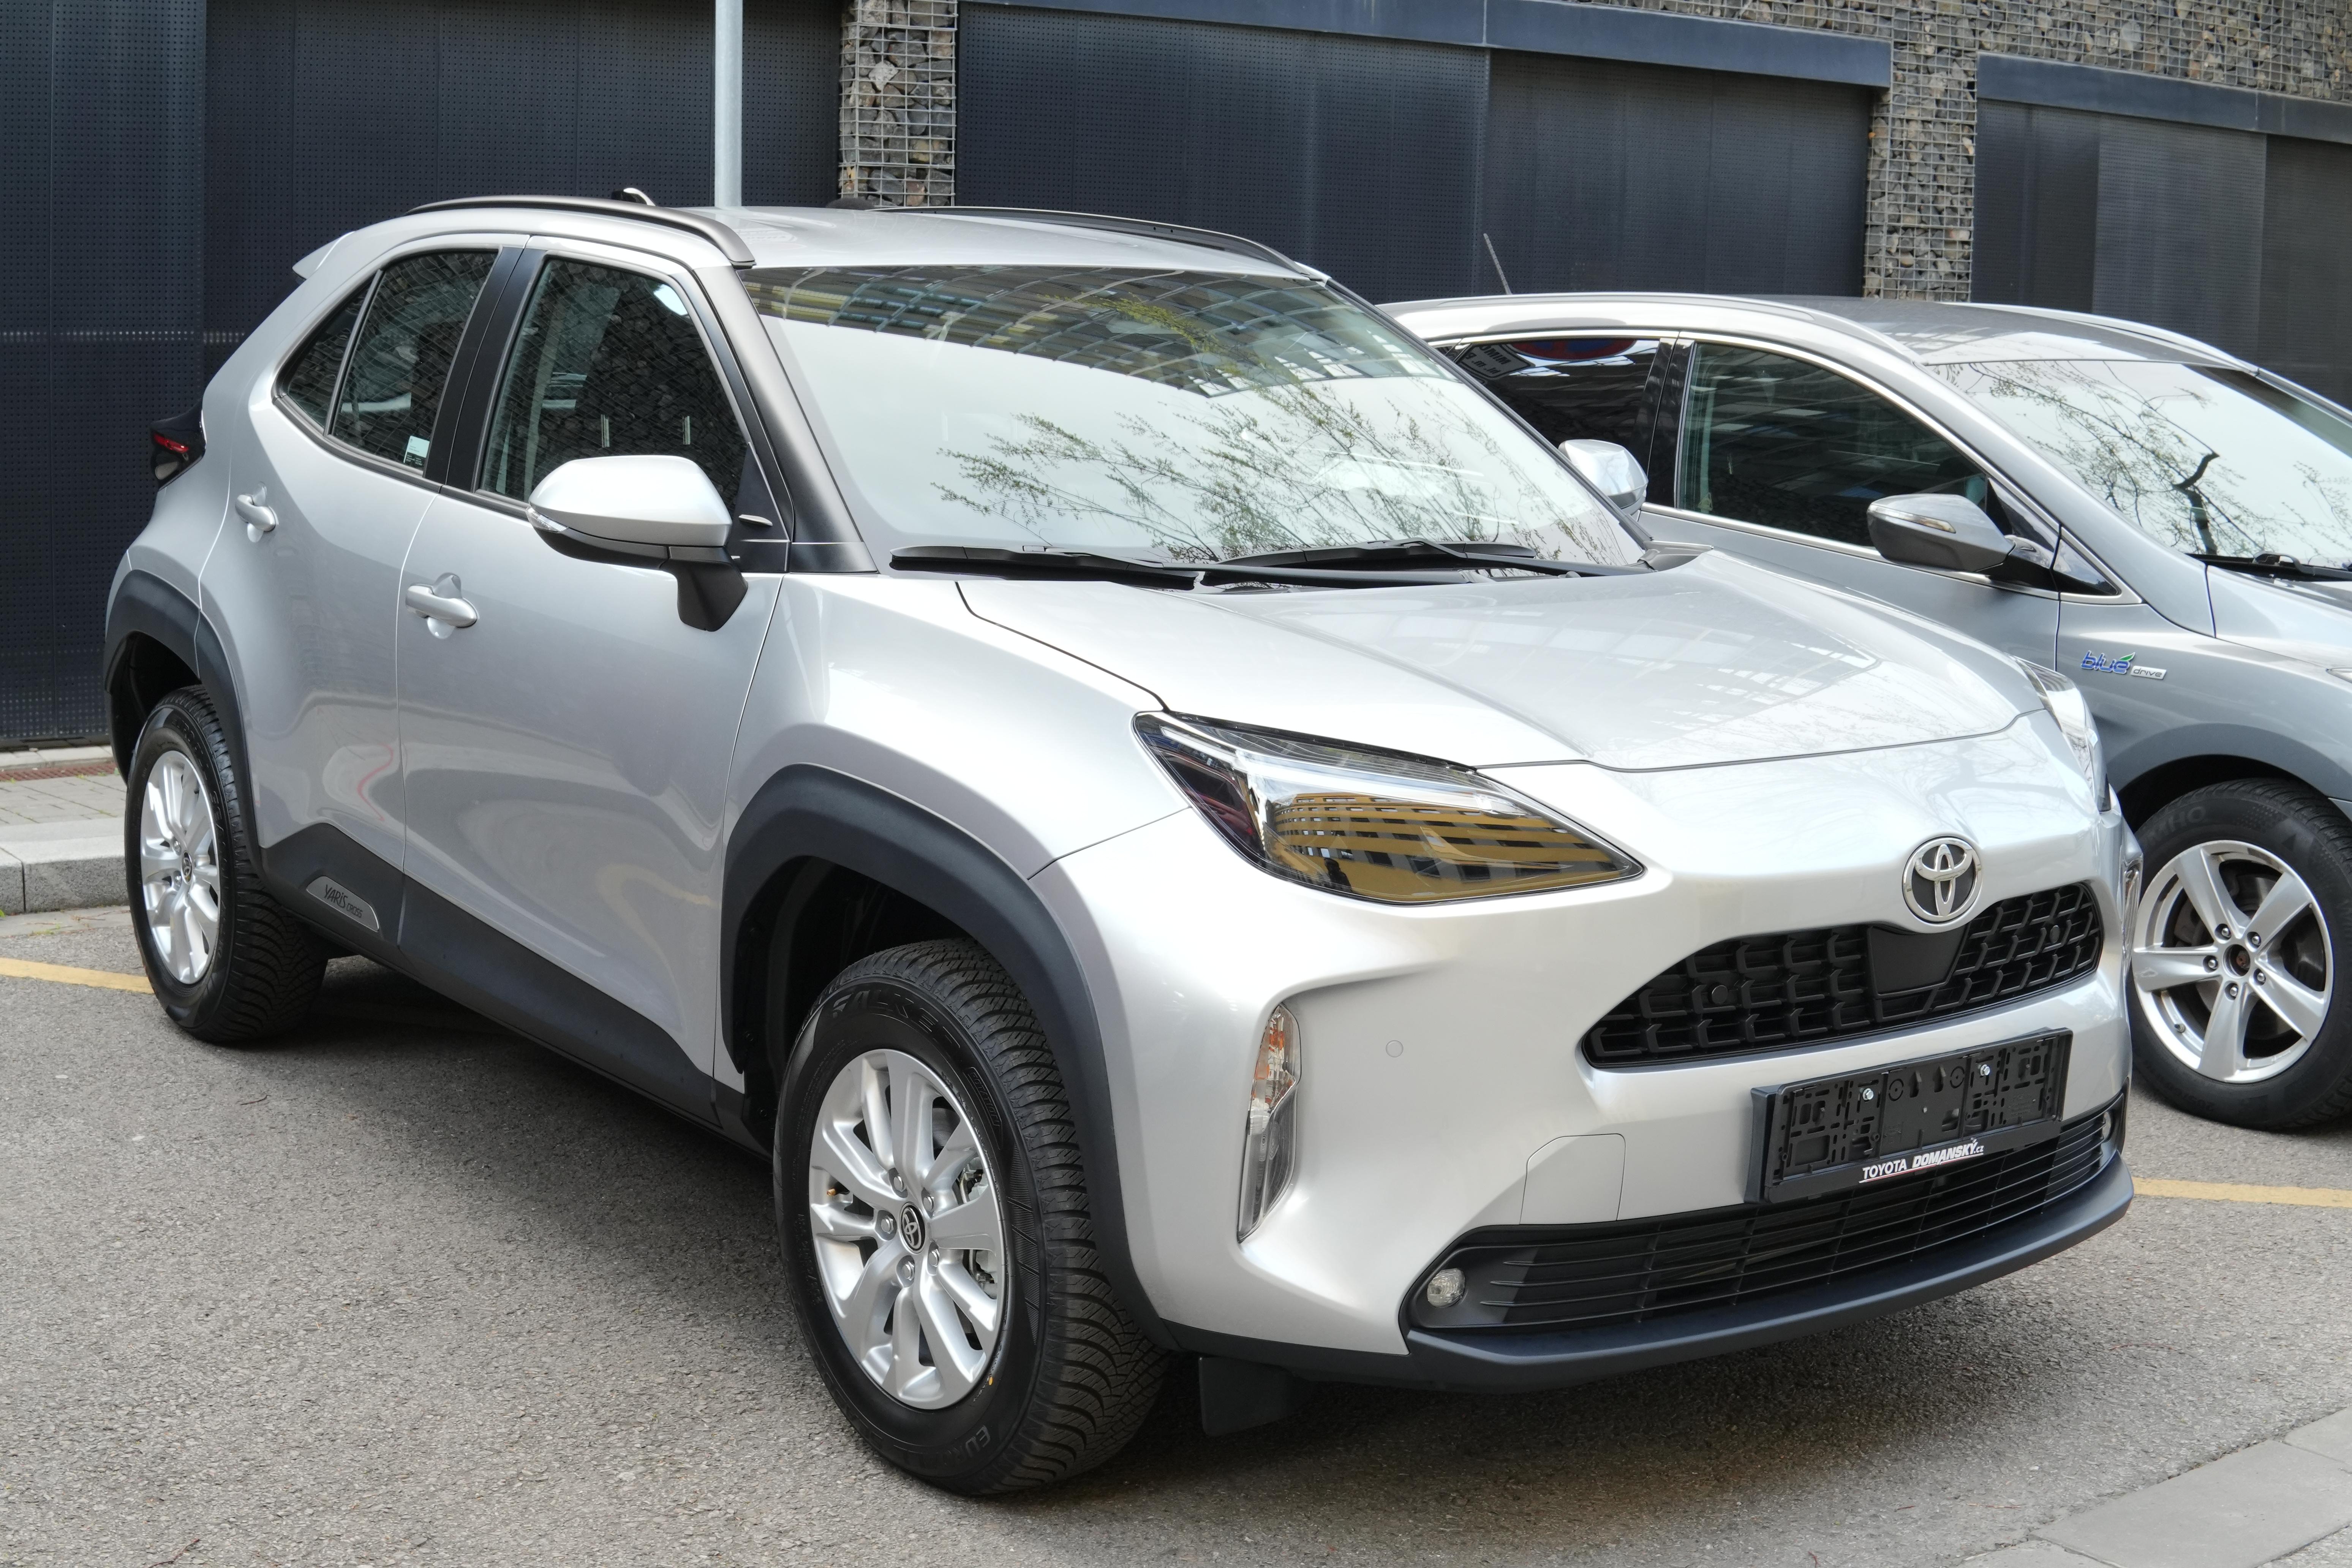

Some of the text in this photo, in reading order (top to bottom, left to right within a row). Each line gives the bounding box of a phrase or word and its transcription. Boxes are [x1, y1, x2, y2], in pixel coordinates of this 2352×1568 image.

[2081, 650, 2162, 677] blue drive
[1862, 1159, 1907, 1179] TOYOTA
